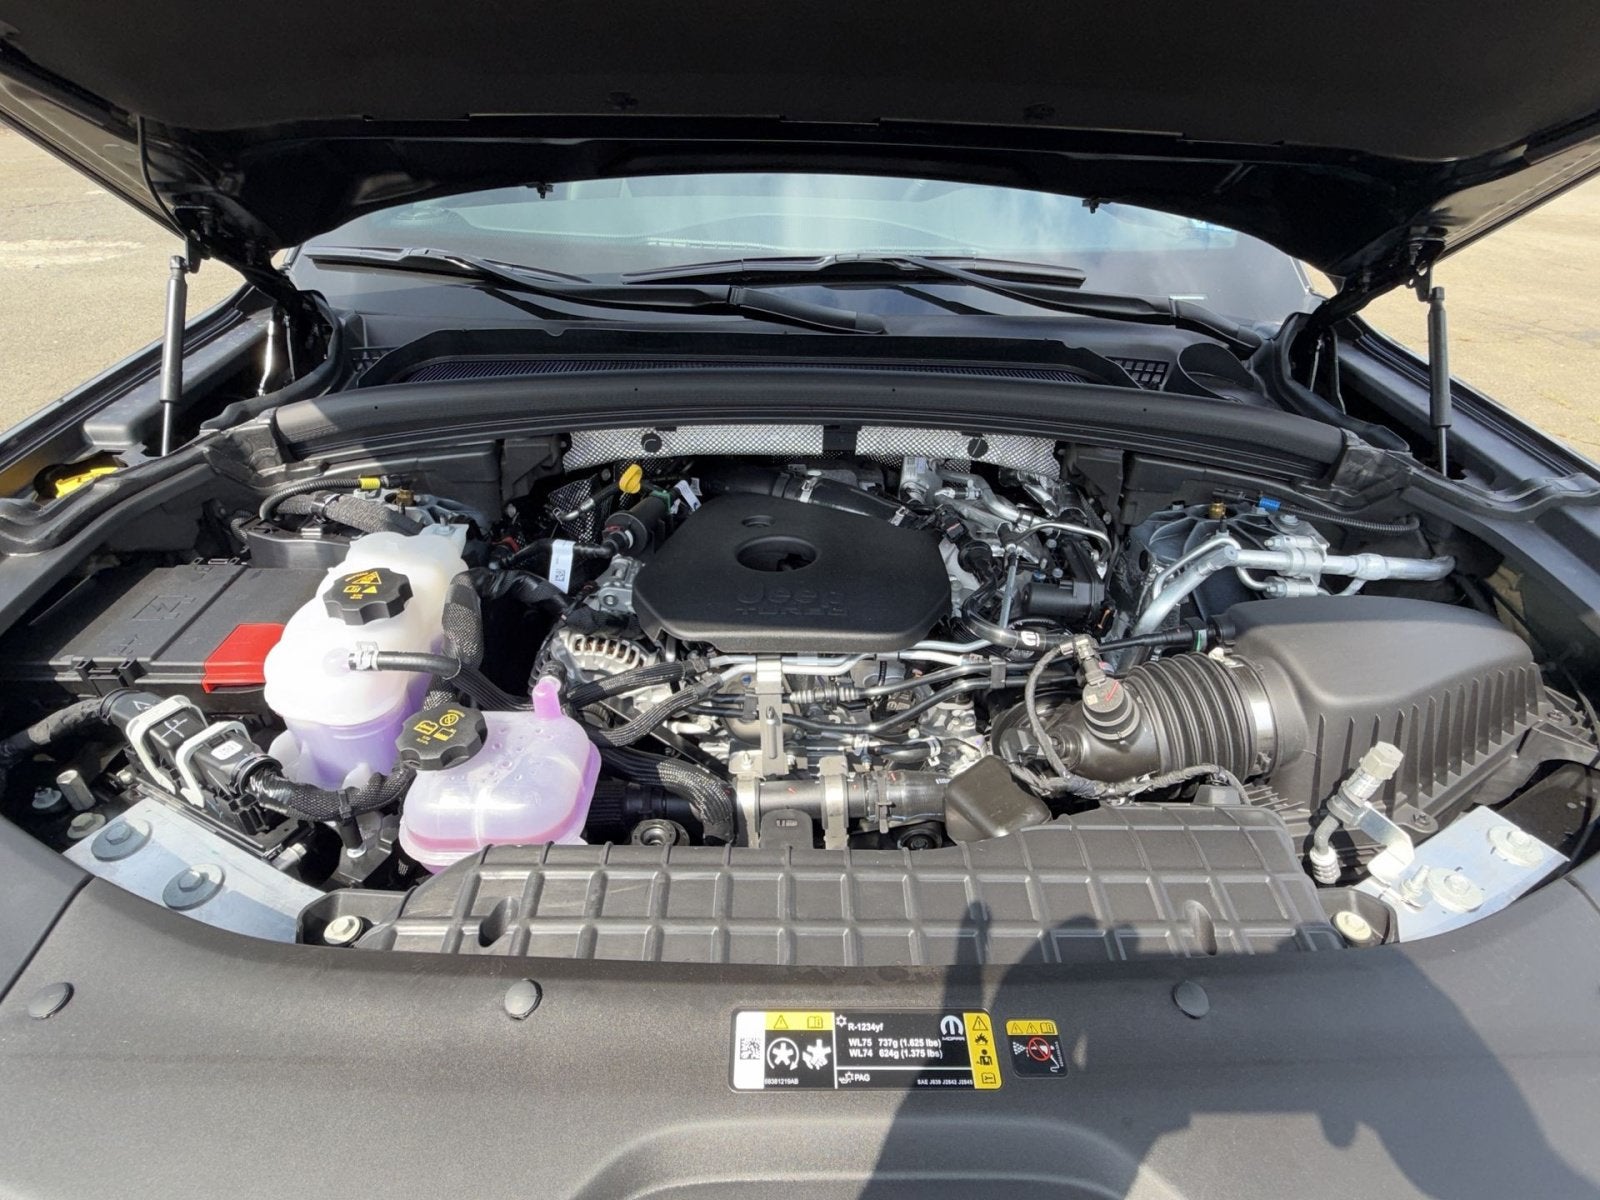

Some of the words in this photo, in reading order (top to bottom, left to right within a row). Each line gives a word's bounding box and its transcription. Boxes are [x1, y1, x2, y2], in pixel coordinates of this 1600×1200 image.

[848, 1022, 884, 1033] R-1234yf
[848, 1038, 872, 1047] WL75
[878, 1038, 898, 1048] 737g
[900, 1038, 924, 1048] (1.625
[926, 1038, 942, 1048] lbs)
[849, 1049, 873, 1058] WL74
[879, 1049, 899, 1059] 624g
[900, 1049, 925, 1059] (1.375
[927, 1049, 943, 1059] lbs)
[854, 1073, 871, 1082] PAG
